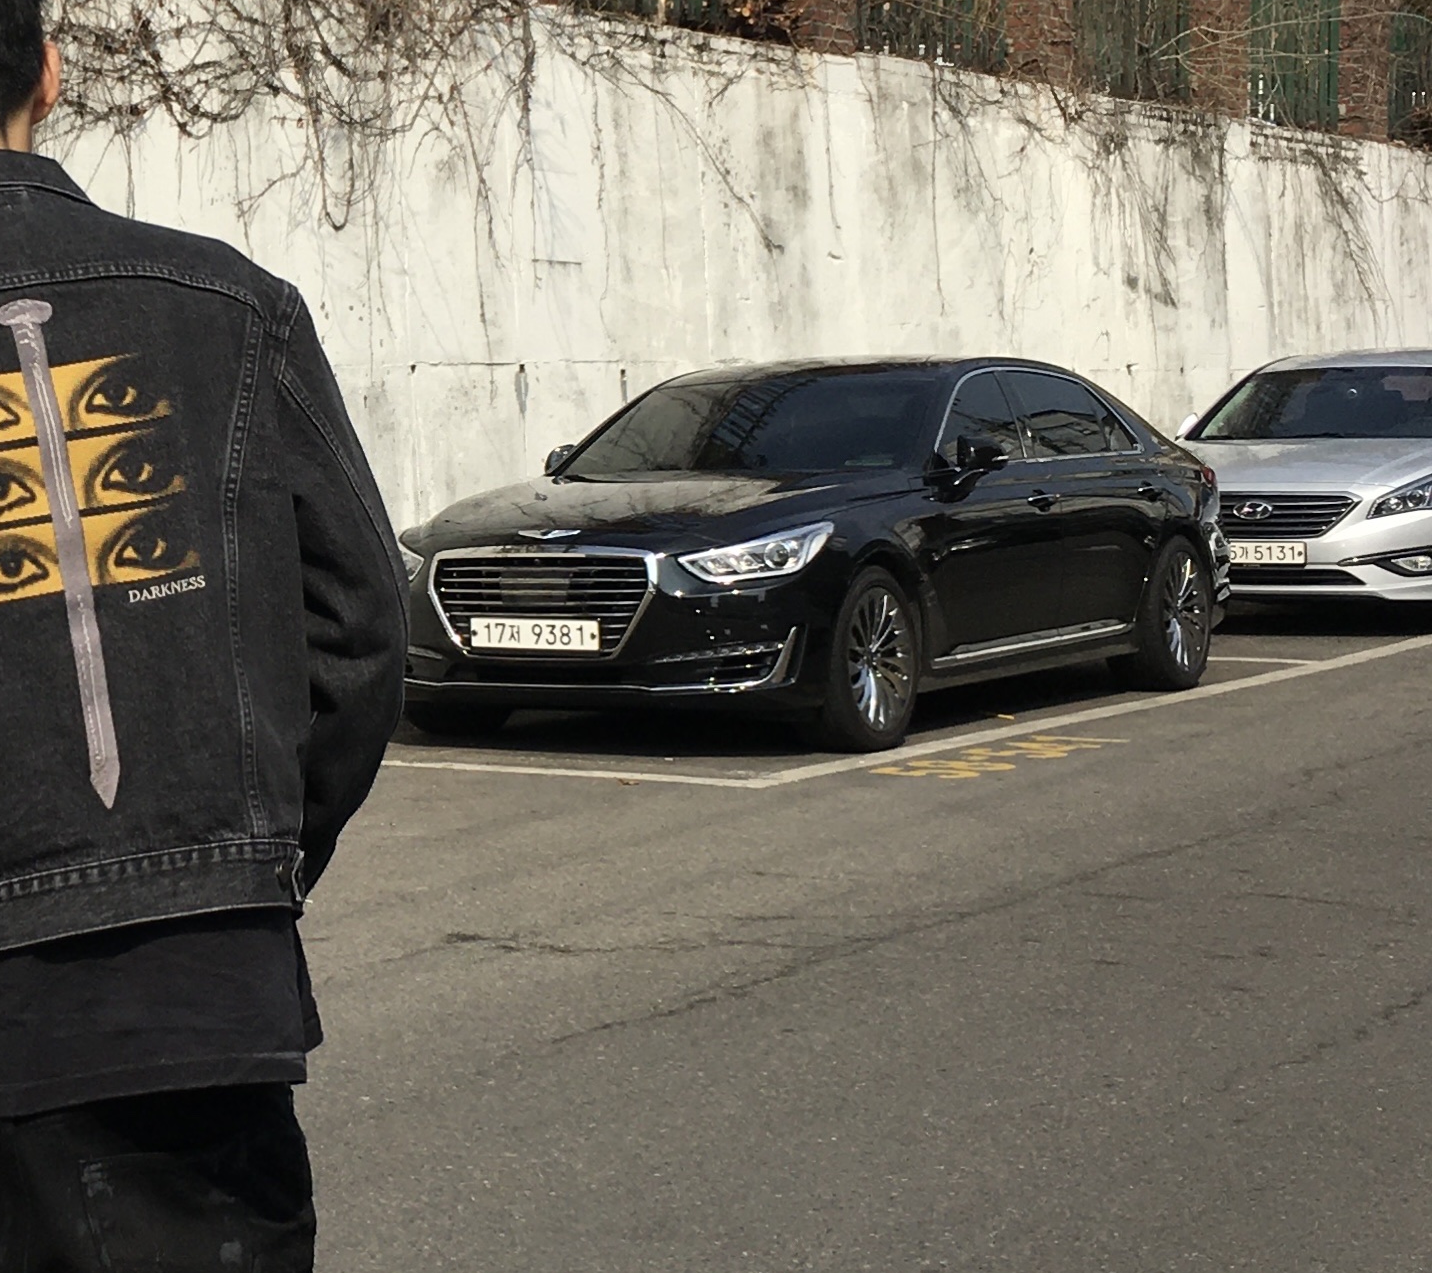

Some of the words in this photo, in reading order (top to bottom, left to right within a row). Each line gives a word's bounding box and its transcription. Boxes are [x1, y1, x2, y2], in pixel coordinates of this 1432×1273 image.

[1254, 545, 1295, 561] 5131
[128, 574, 206, 603] DARKNESS
[483, 622, 521, 644] 17저
[531, 623, 585, 646] 9381
